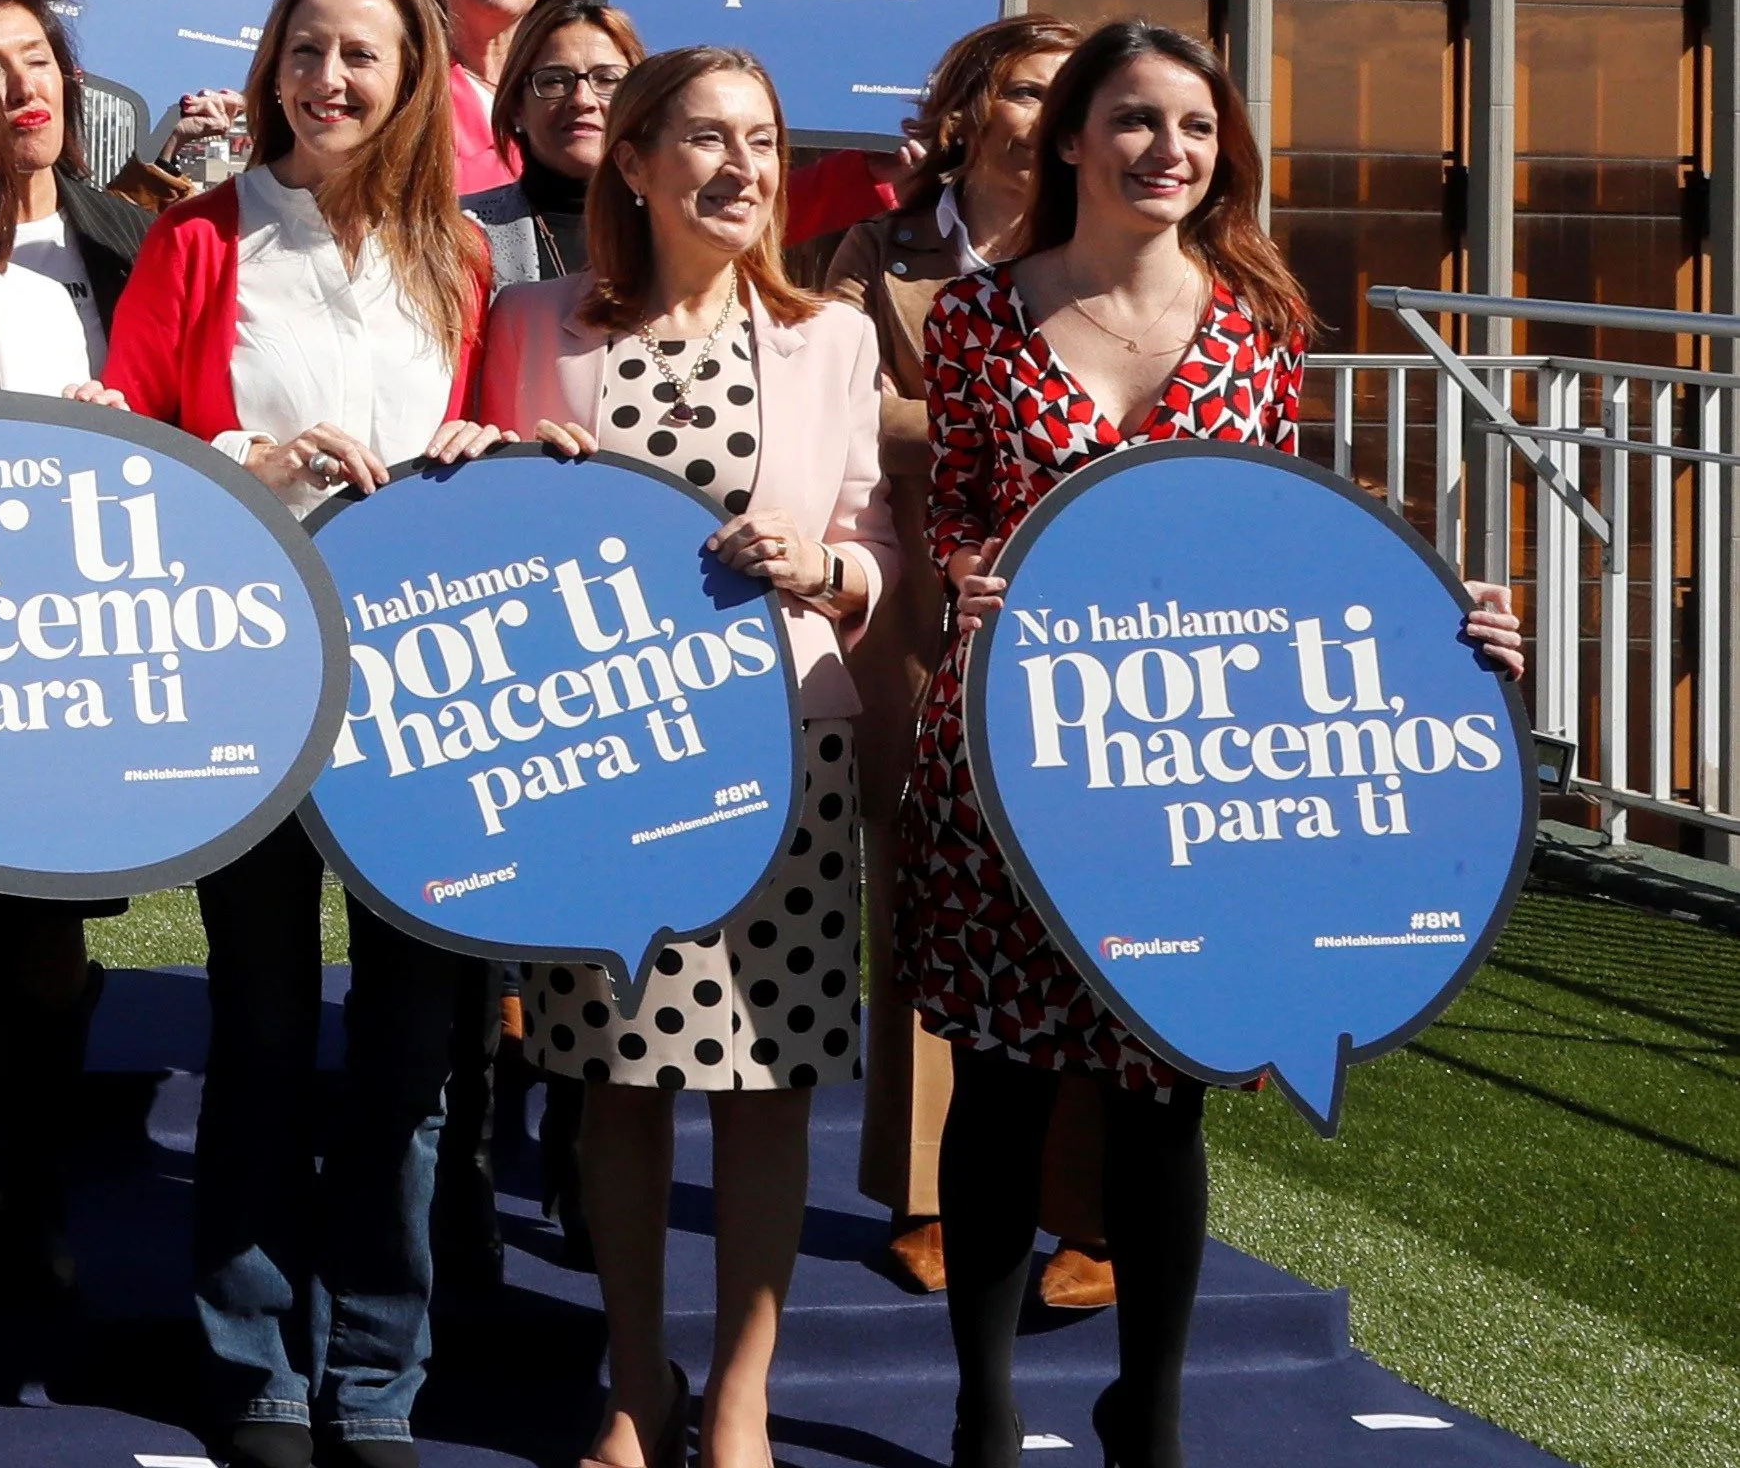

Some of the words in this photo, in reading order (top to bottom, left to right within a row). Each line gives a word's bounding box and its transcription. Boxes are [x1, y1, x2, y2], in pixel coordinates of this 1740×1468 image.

[61, 454, 187, 588] ti,
[353, 554, 550, 634] hablamos
[552, 536, 674, 655] ti,
[1011, 607, 1079, 647] No
[1088, 600, 1290, 644] hablamos
[129, 653, 189, 726] ti
[389, 617, 777, 779] hacemos
[1018, 642, 1261, 769] por
[1288, 604, 1406, 719] ti,
[123, 765, 261, 782] #NoHablamosHacemos
[210, 744, 255, 764] #8M
[468, 736, 641, 837] para
[646, 696, 708, 764] ti
[1086, 712, 1502, 790] hacemos
[631, 798, 769, 847] #NoHablamosHacemos
[713, 780, 762, 808] #8M
[1163, 794, 1341, 867] para
[1354, 774, 1411, 837] ti
[432, 867, 517, 904] populares
[1110, 938, 1200, 960] populares
[1313, 932, 1467, 949] #NoHablamosHacemos
[1410, 911, 1462, 931] #8M
